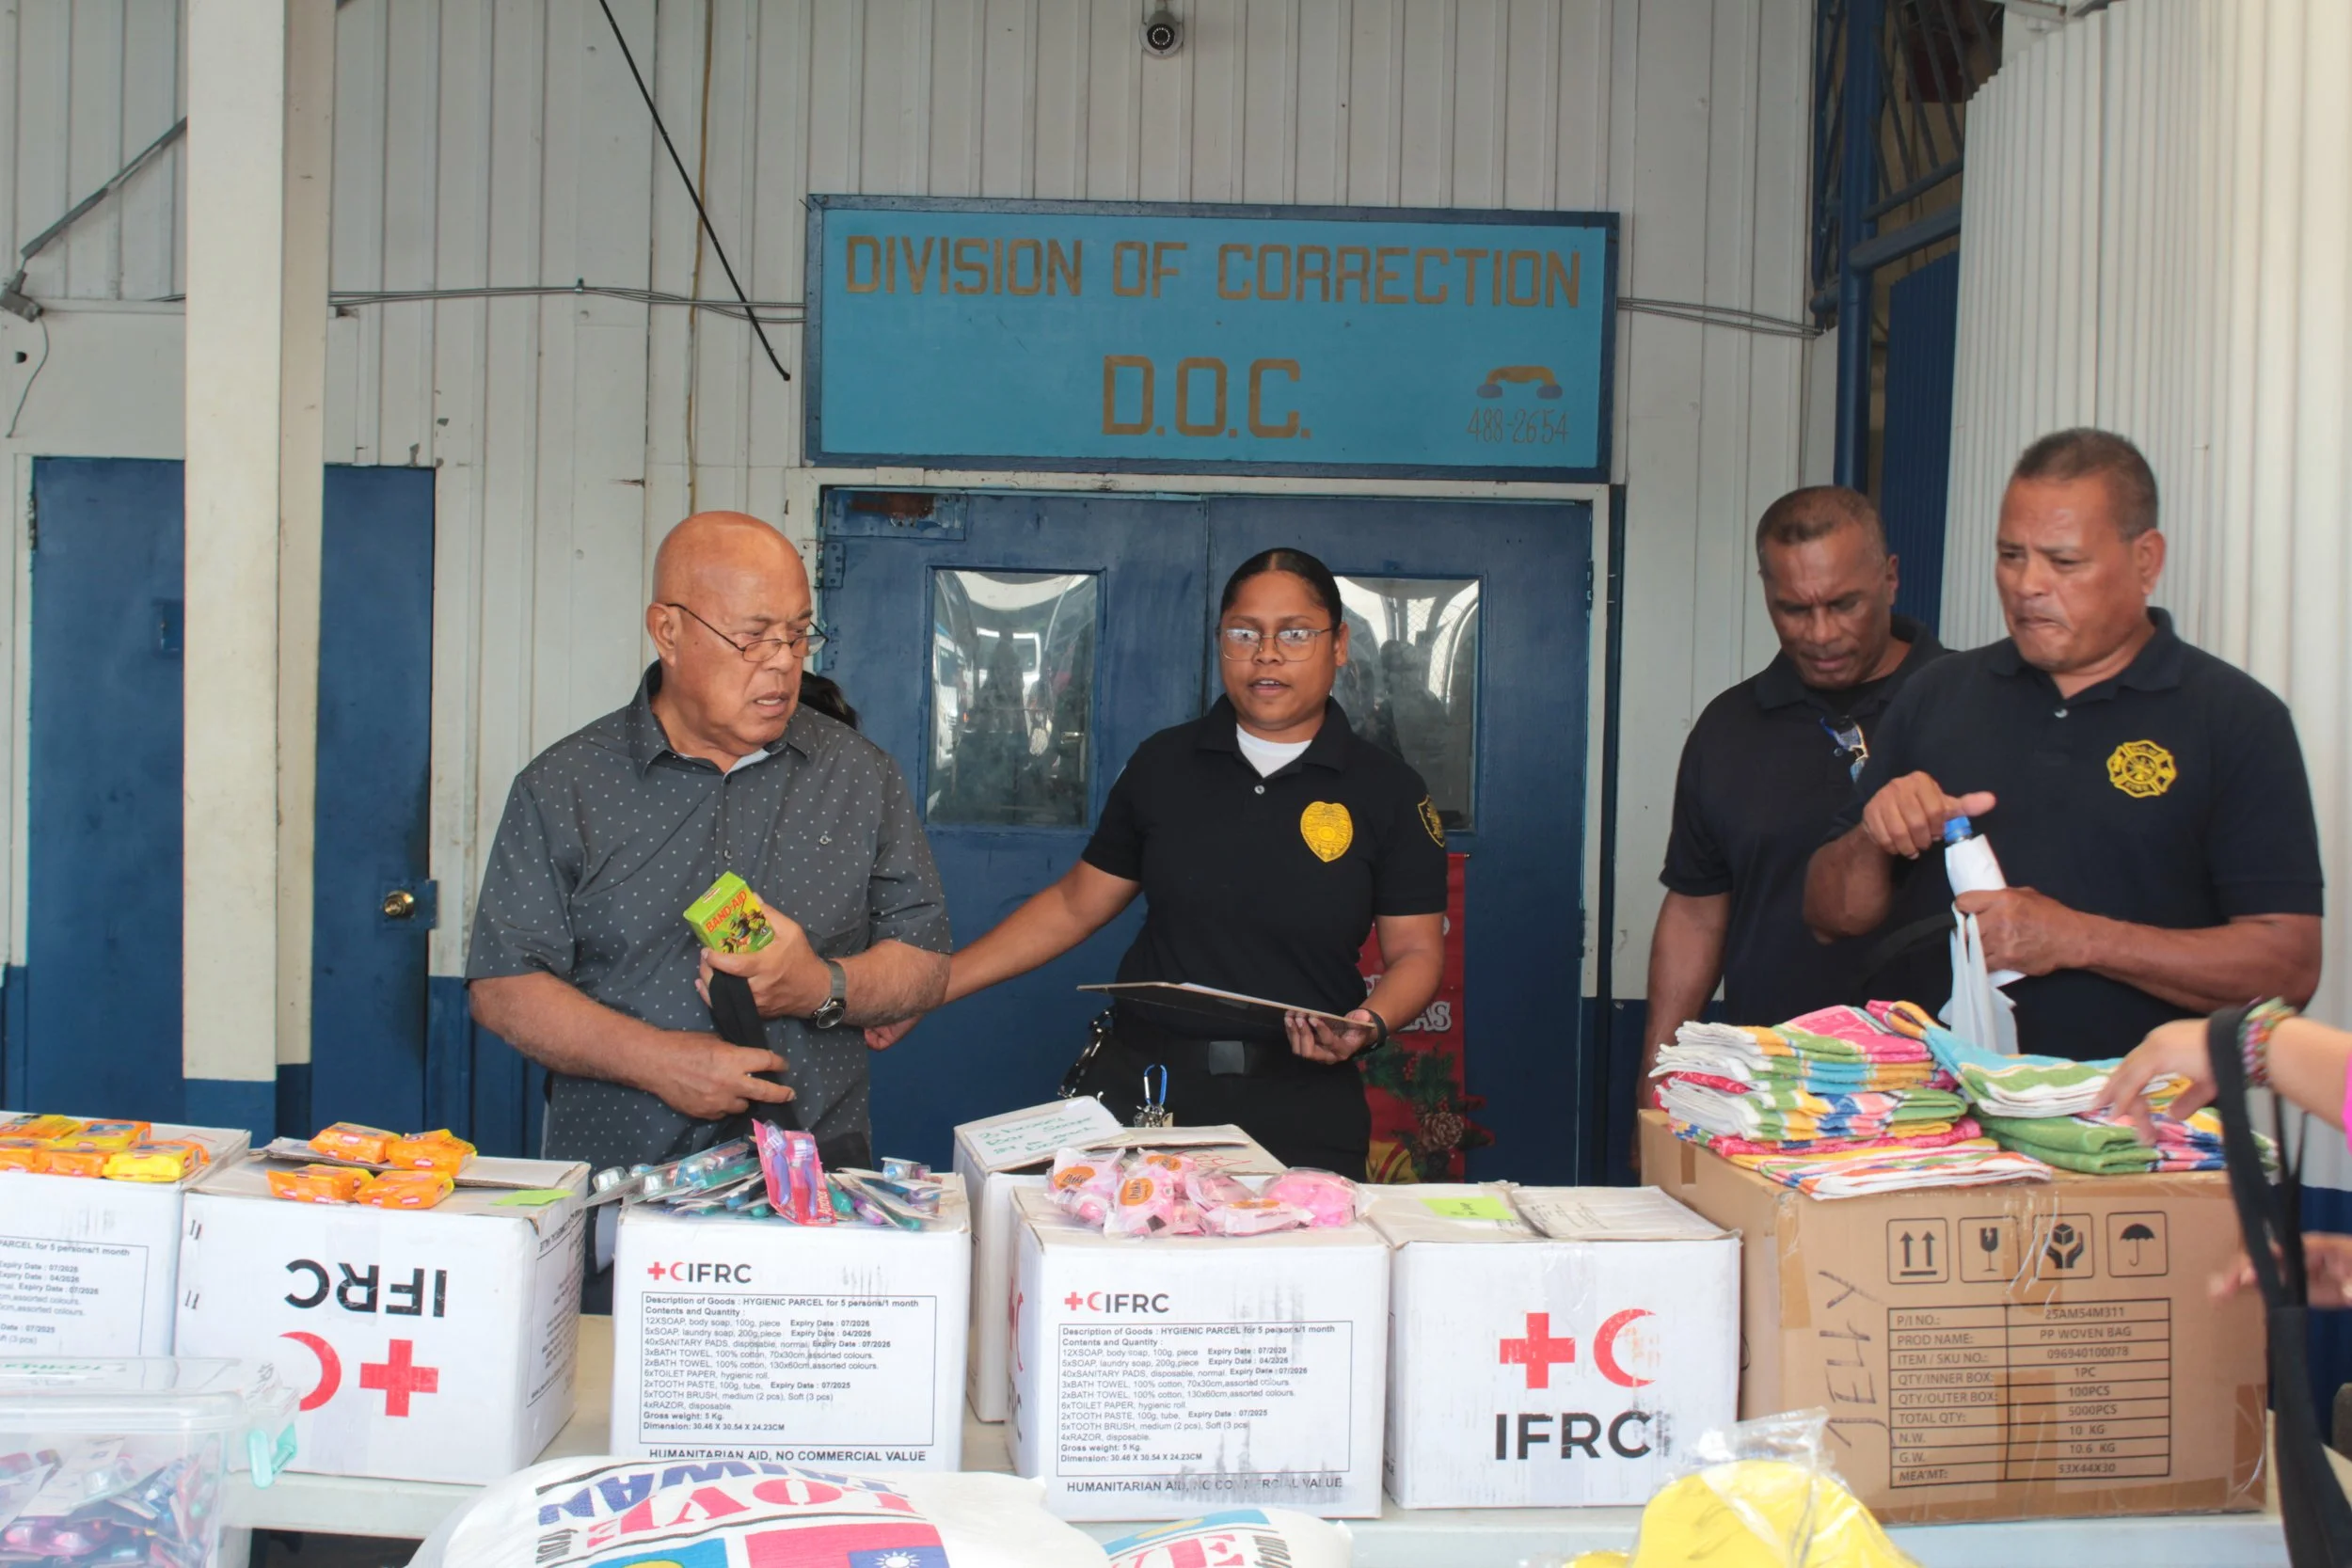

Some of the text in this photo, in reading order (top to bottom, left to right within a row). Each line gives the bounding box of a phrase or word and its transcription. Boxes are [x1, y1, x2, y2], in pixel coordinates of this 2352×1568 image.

[846, 234, 1580, 309] DIVISION OF CORRECTION
[1102, 354, 1311, 439] D.O.C.
[1466, 406, 1569, 444] 488-2654
[706, 890, 747, 933] BAND-AID
[36, 1242, 47, 1250] for
[102, 1247, 130, 1256] month
[688, 1262, 753, 1284] IFRC
[19, 1283, 43, 1293] Expiry
[283, 1259, 447, 1317] IFRC
[645, 1295, 693, 1305] Description
[707, 1296, 735, 1305] Goods
[742, 1297, 786, 1306] HYGIENIC
[848, 1298, 888, 1307] persons/1
[892, 1299, 918, 1307] month
[1106, 1292, 1169, 1313] IFRC
[644, 1306, 739, 1316] Contents and Quantity
[689, 1318, 707, 1327] body
[758, 1319, 781, 1327] piece
[789, 1319, 814, 1327] Expiry
[1896, 1314, 1913, 1326] P/I
[682, 1328, 712, 1338] laundry
[790, 1329, 815, 1338] Expiry
[1062, 1327, 1111, 1337] Description
[1160, 1326, 1203, 1335] HYGIENIC
[2039, 1325, 2132, 1339] PP WOVEN BAG
[644, 1338, 702, 1346] 40xSANITARY
[812, 1339, 836, 1348] Expiry
[1062, 1337, 1158, 1347] Contents and Quantity
[1897, 1333, 1973, 1346] PROD NAME:
[1897, 1354, 1926, 1365] ITEM
[1936, 1352, 1960, 1364] SKU
[644, 1369, 685, 1378] 6xTOILET
[720, 1370, 753, 1380] hygienic
[1898, 1370, 1994, 1386] QTY/INNER BOX:
[2074, 1367, 2096, 1378] 1PC
[644, 1379, 684, 1388] 2xTOOTH
[770, 1381, 794, 1389] Expiry
[2068, 1385, 2109, 1397] 100PCS
[1898, 1390, 1998, 1405] QTY/OUTER BOX:
[643, 1400, 686, 1409] 4xRAZOR,
[1061, 1401, 1102, 1410] 6xTOILET
[1137, 1401, 1170, 1411] hygienic
[2068, 1403, 2117, 1417] 5000PCS
[671, 1411, 702, 1420] weight:
[1899, 1410, 1966, 1424] TOTAL QTY:
[643, 1421, 691, 1430] Dimension:
[752, 1422, 785, 1431] 24.23CM
[2069, 1424, 2105, 1435] 10 KG
[1060, 1433, 1104, 1442] 4xRAZOR,
[1495, 1411, 1653, 1461] IFRC
[1899, 1432, 1926, 1444] N.W.
[1060, 1443, 1086, 1451] Gross
[1089, 1443, 1120, 1452] weight:
[2069, 1442, 2115, 1454] 10.6 KG
[648, 1449, 926, 1462] HUMANITARIAN AID, NO COMMERCIAL VALUE
[1060, 1453, 1109, 1463] Dimension:
[1169, 1452, 1202, 1461] 24.23CM
[1899, 1450, 1925, 1464] G.W.
[1067, 1480, 1161, 1492] HUMANITARIAN
[537, 1461, 909, 1526] TAIWAN
[586, 1478, 918, 1548] LOVE
